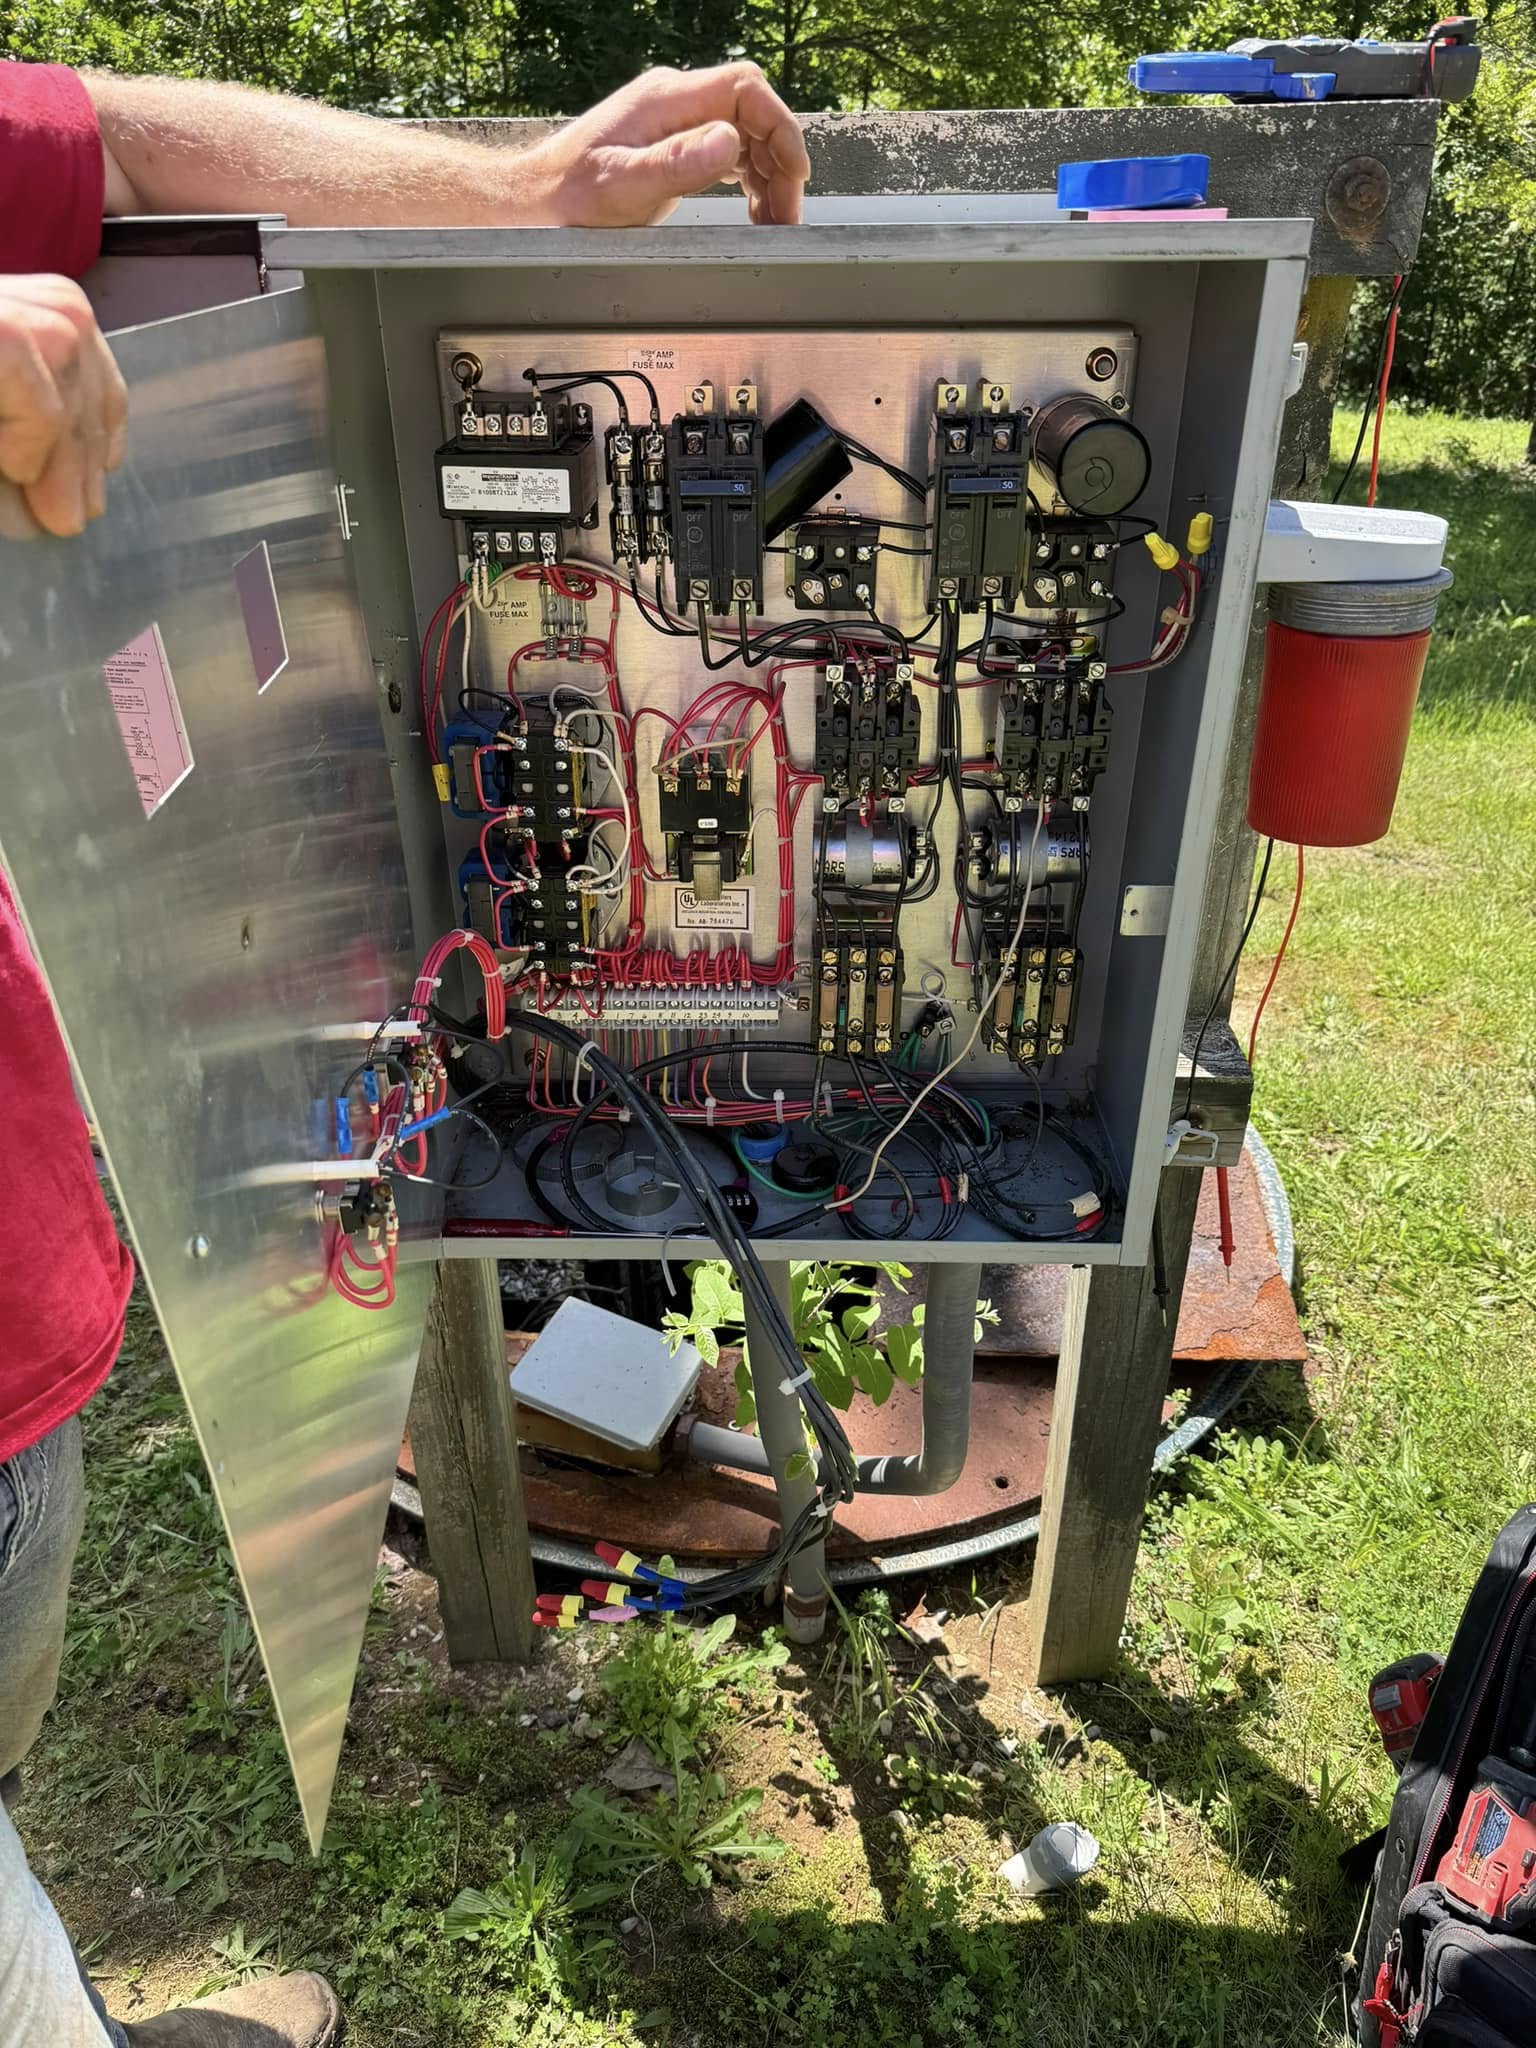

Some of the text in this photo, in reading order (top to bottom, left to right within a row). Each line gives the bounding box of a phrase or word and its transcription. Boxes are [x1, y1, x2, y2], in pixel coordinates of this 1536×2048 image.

[632, 361, 674, 369] FUSE MAX
[734, 483, 744, 491] 50
[1002, 481, 1013, 489] 50
[510, 601, 527, 609] AMP
